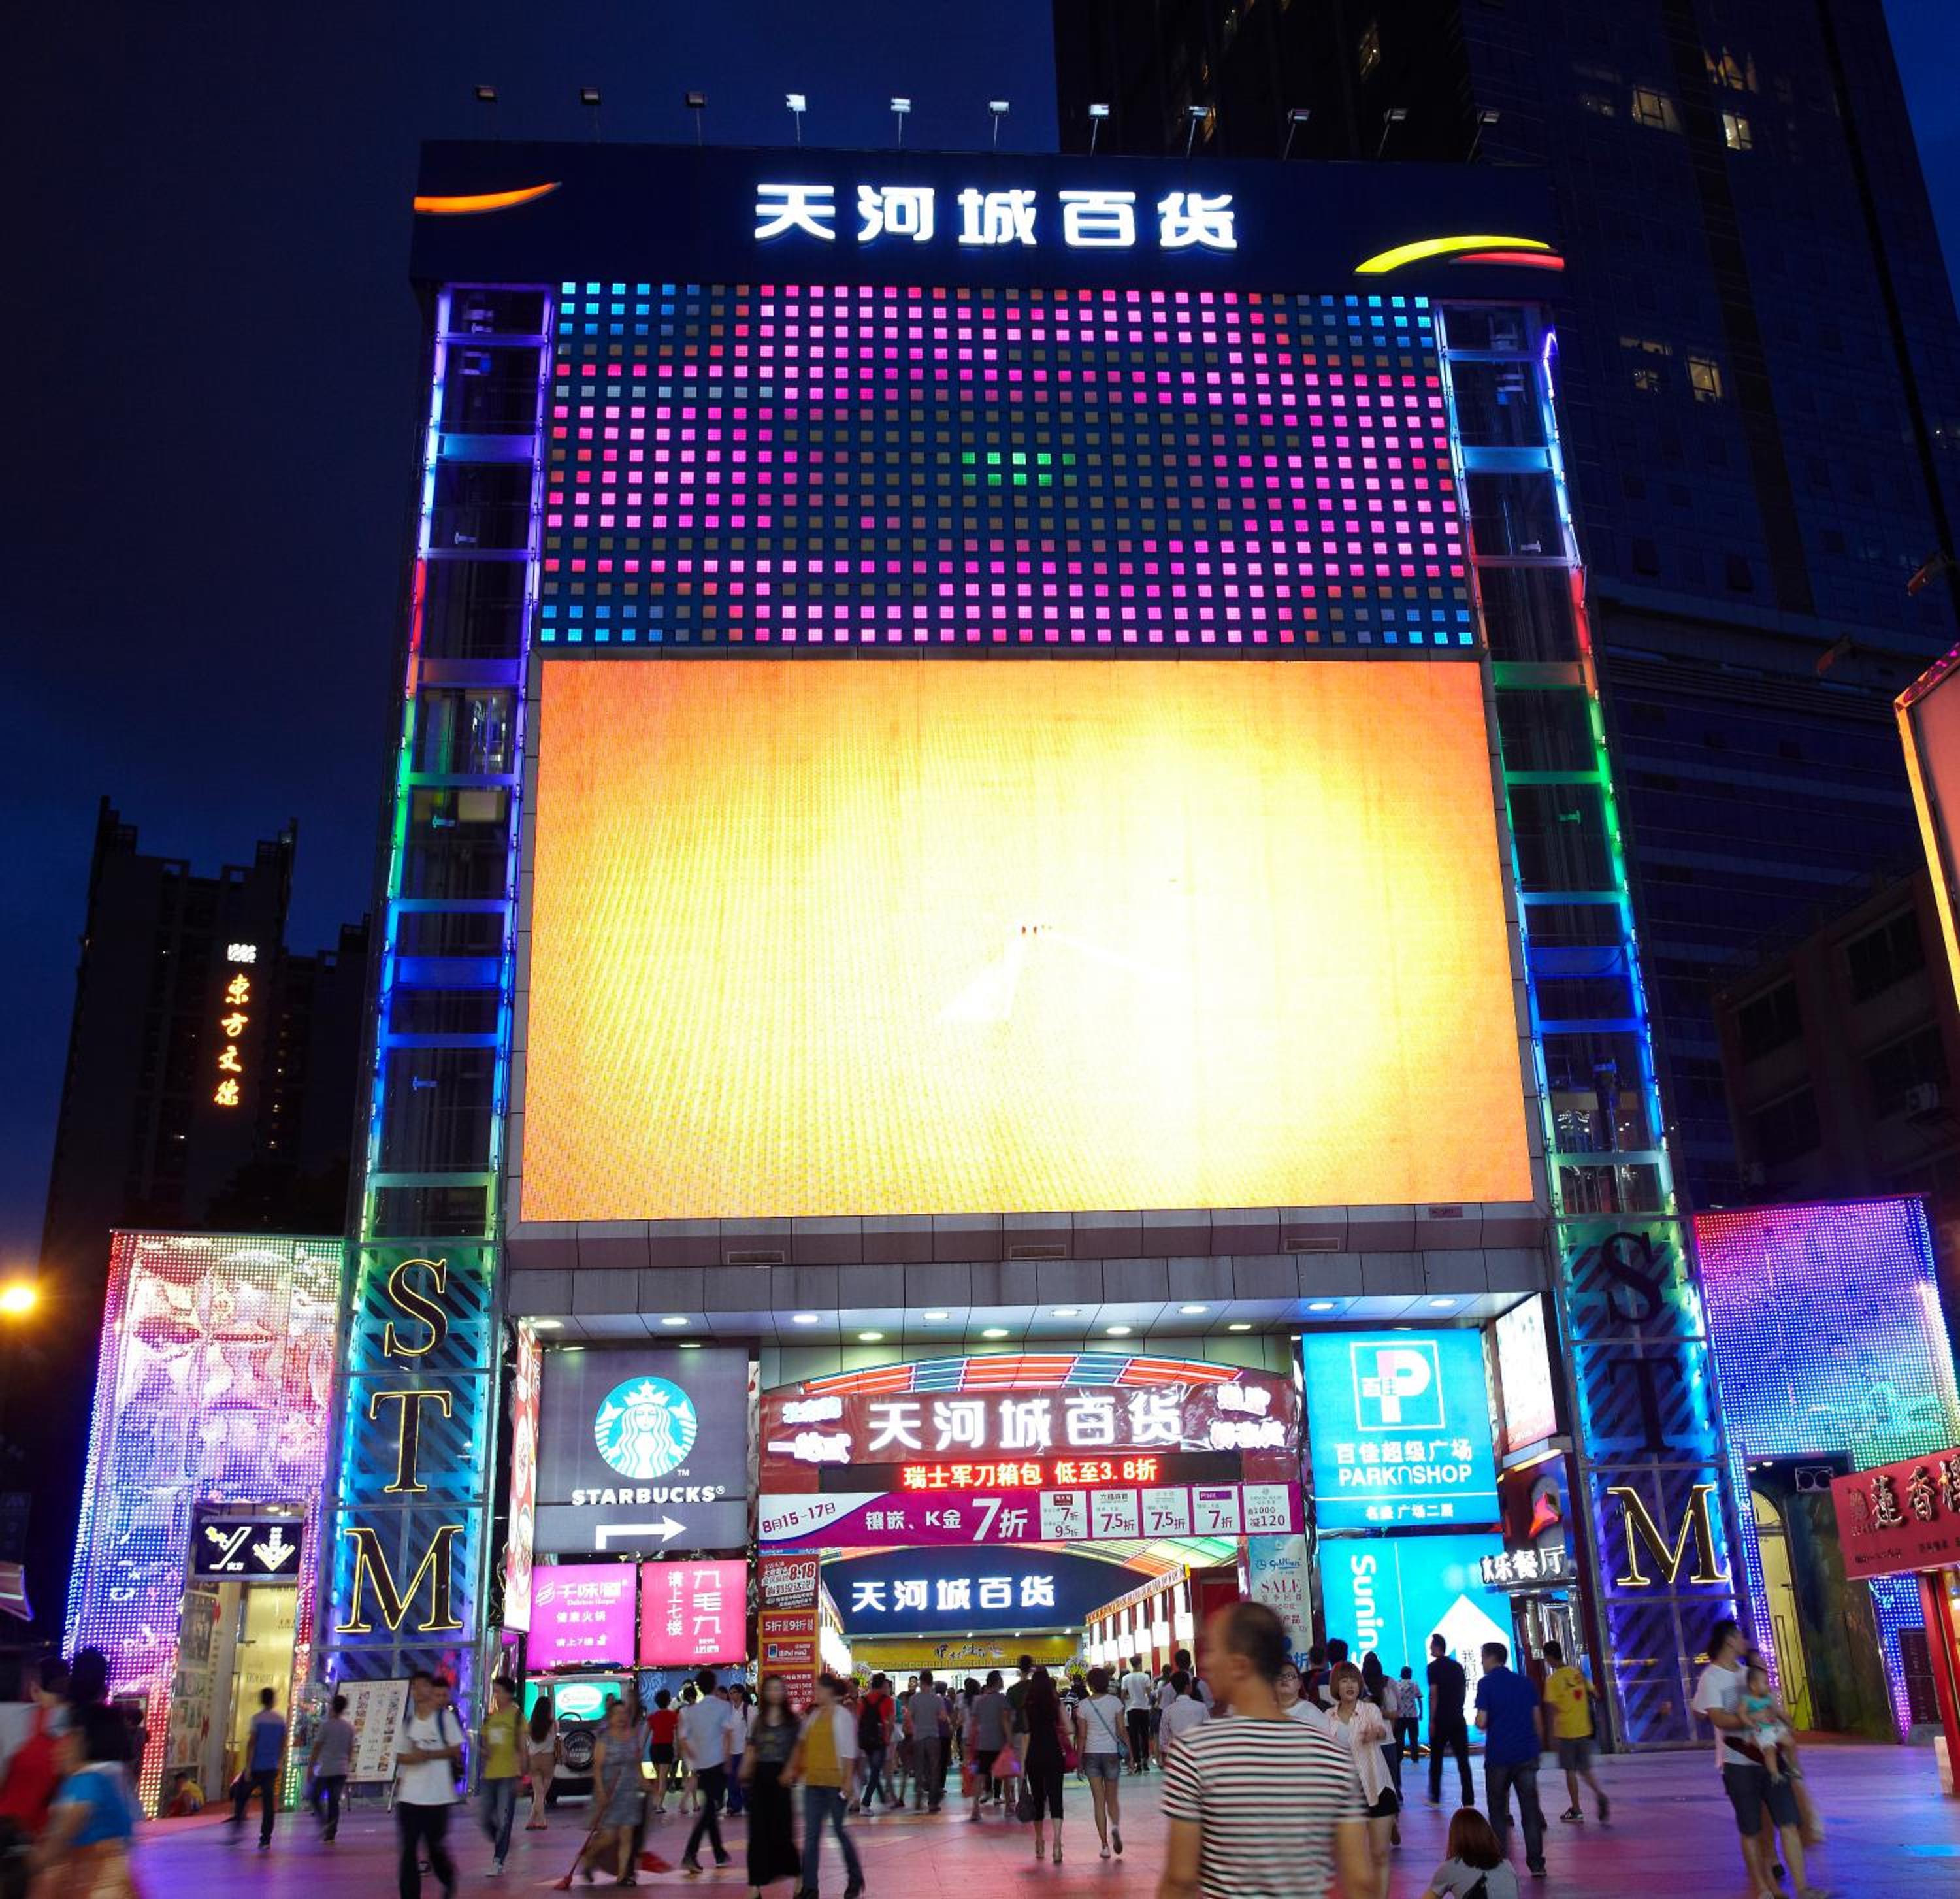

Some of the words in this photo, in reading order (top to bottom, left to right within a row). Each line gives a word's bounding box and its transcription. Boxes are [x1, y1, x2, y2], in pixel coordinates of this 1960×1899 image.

[755, 184, 1238, 250] 天河城百货
[868, 1393, 1183, 1452] 天河城百货
[1334, 1438, 1473, 1464] 百佳超级广场
[904, 1462, 1043, 1489] 瑞士军刀箱包
[1055, 1457, 1158, 1485] 低至3.8折
[972, 1498, 1028, 1541] 7折
[1208, 1510, 1232, 1528] 7折
[666, 1571, 683, 1636] 请上七楼
[693, 1570, 722, 1635] 九毛九
[852, 1576, 1055, 1612] 天河城百货
[1261, 1579, 1302, 1593] SALE
